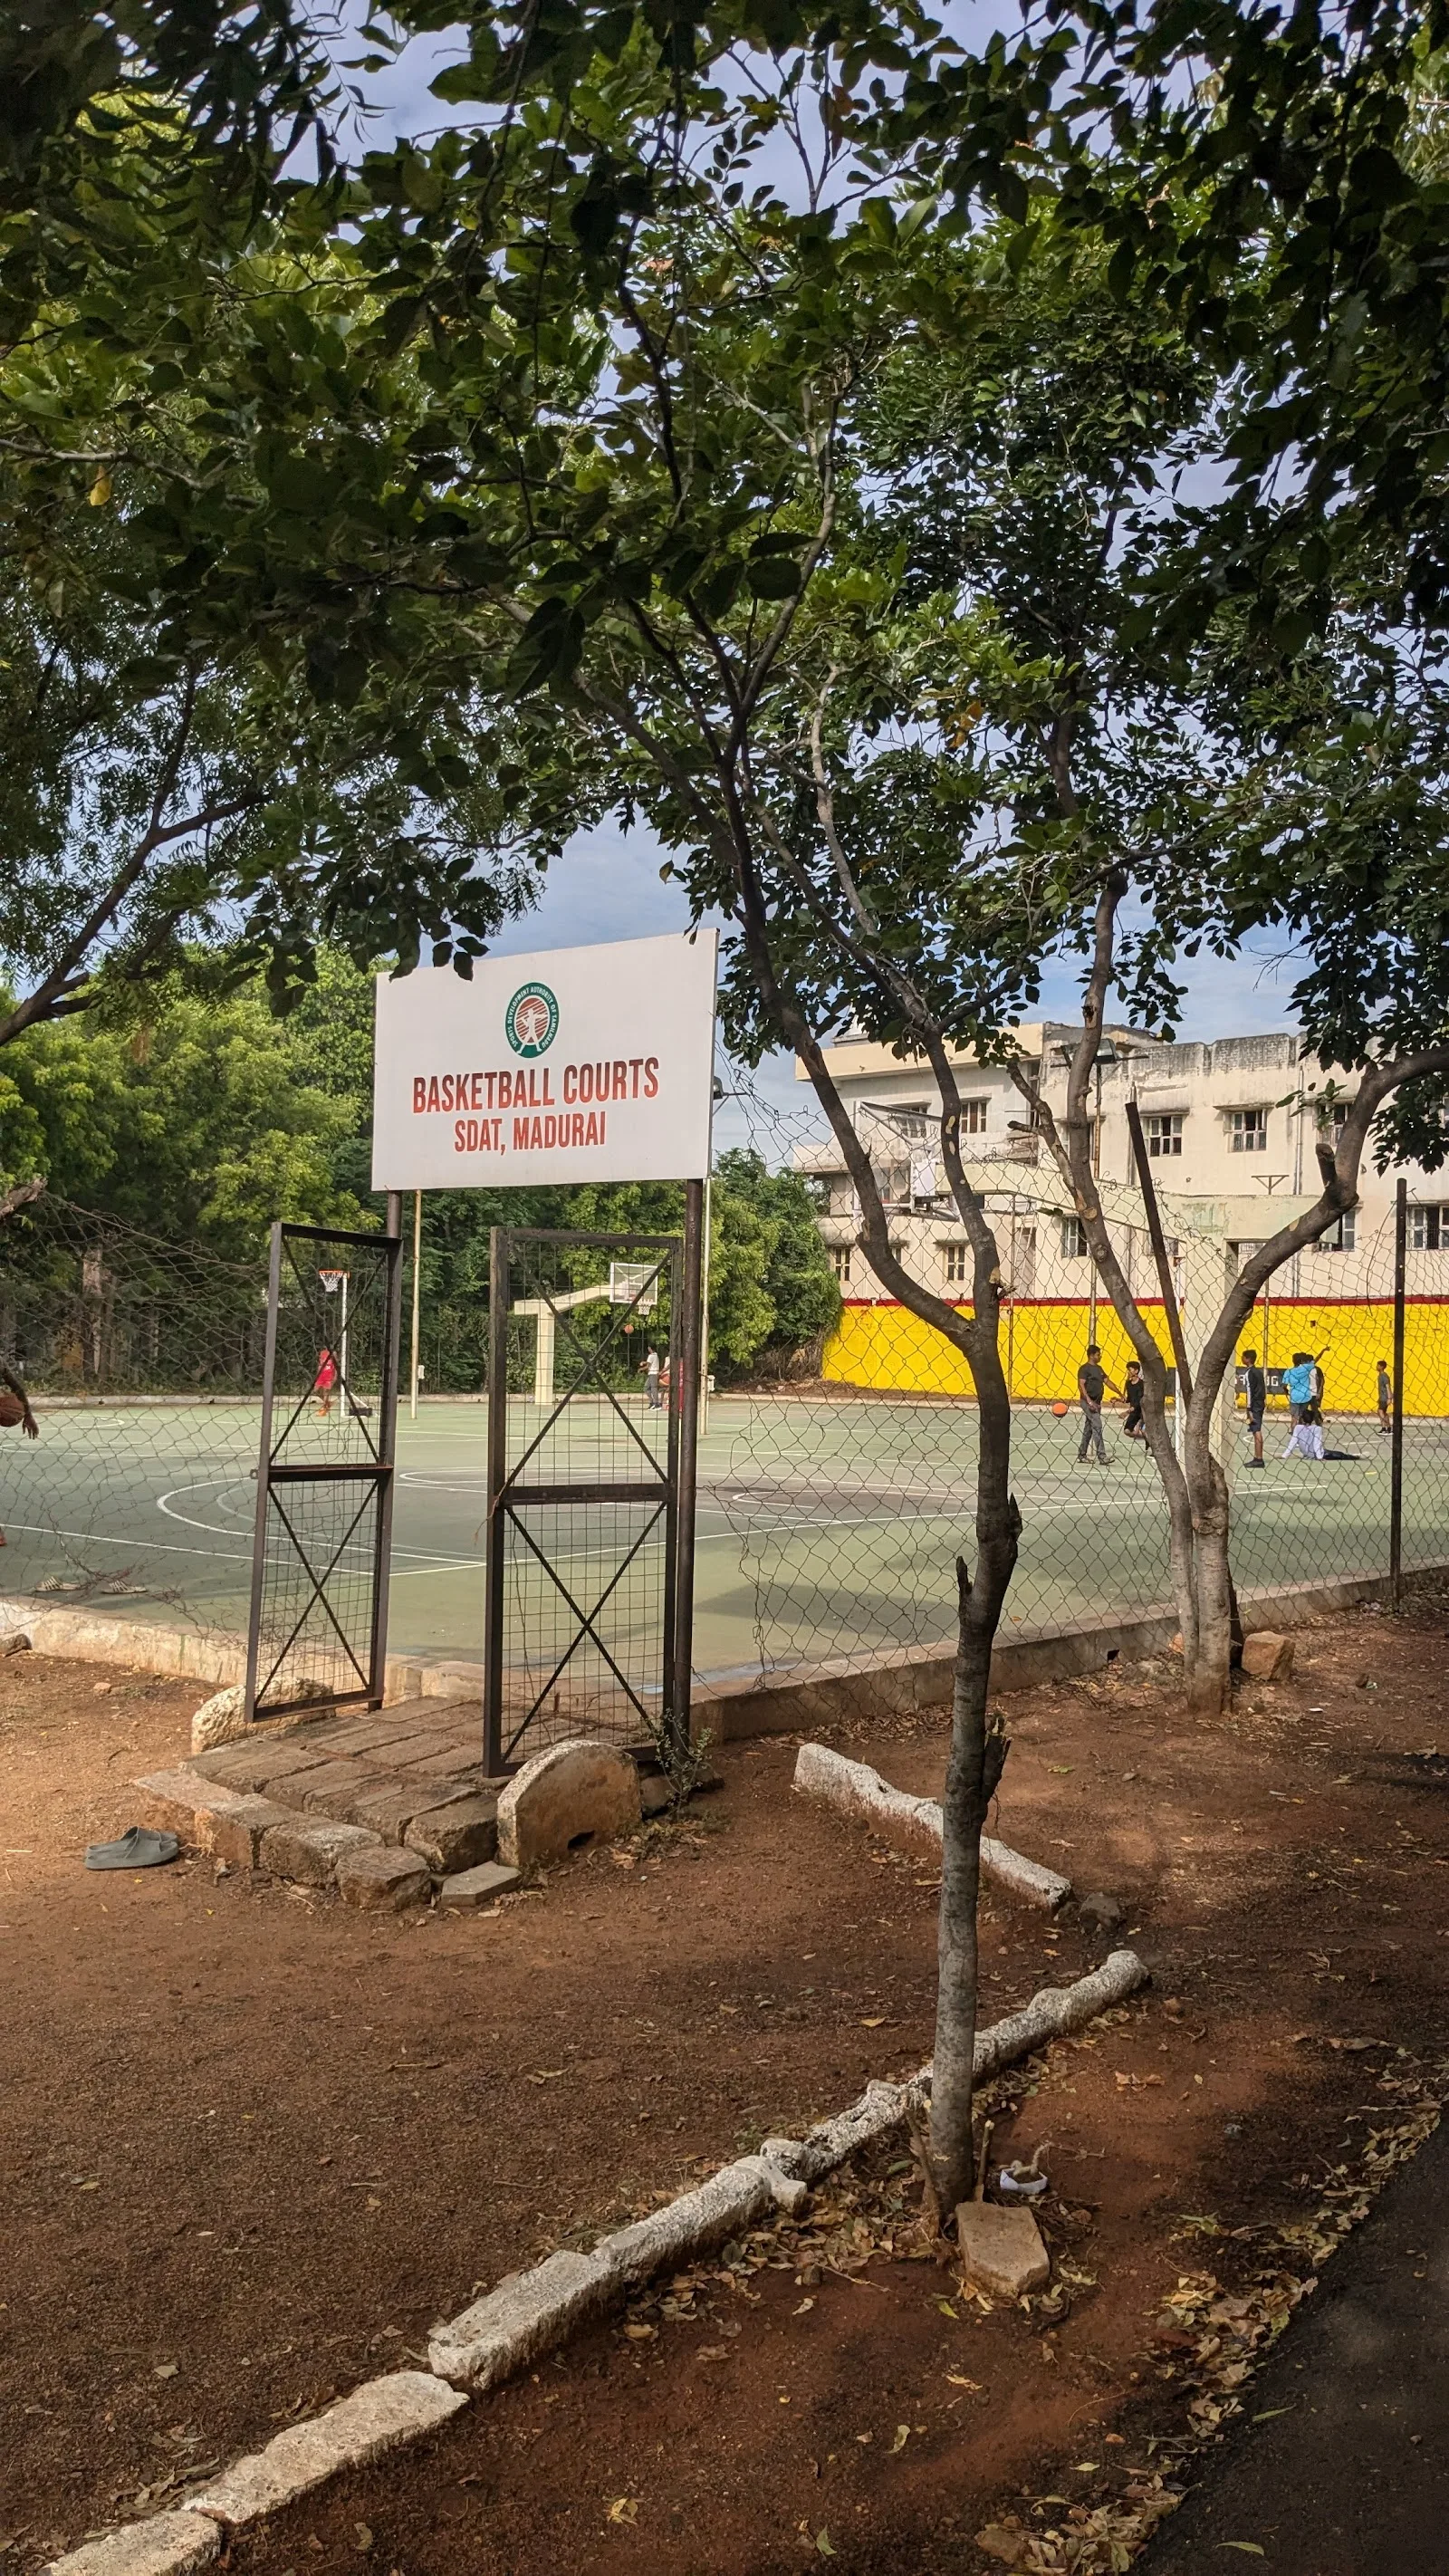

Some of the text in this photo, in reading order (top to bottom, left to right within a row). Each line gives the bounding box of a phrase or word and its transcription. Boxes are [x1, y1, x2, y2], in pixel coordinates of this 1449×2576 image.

[530, 985, 553, 1004] AUTHORITY
[550, 1004, 557, 1013] OF
[507, 1025, 518, 1047] SPORTS
[542, 1014, 557, 1048] TAMILNADU
[413, 1056, 659, 1114] BASKETBALL COURTS
[455, 1111, 606, 1155] SDAT, MADURAI
